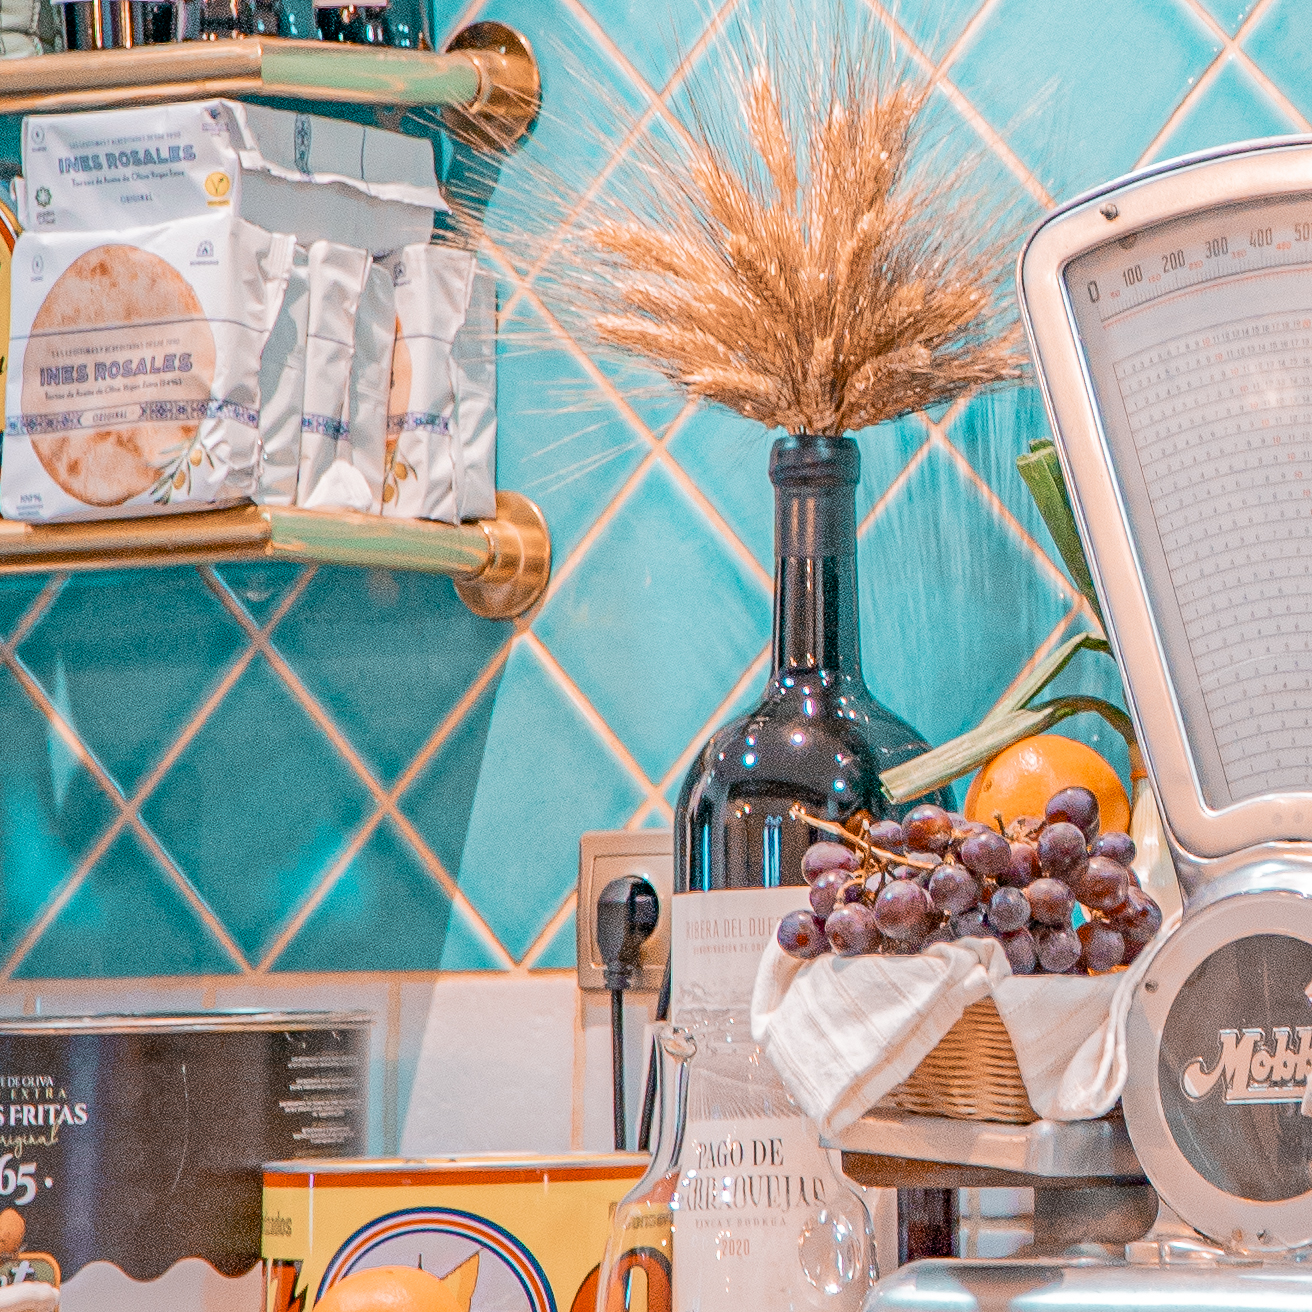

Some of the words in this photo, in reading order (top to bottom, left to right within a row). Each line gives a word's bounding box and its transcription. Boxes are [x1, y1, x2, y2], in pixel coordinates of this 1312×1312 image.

[58, 154, 104, 176] INES
[105, 144, 197, 170] ROSALES
[1087, 280, 1100, 303] 0
[1122, 264, 1143, 288] 100
[1162, 249, 1186, 274] 200
[1205, 236, 1229, 260] 300
[1249, 226, 1273, 248] 400
[40, 363, 89, 387] INES
[94, 352, 193, 382] ROSALES
[685, 919, 720, 940] RIBERA
[723, 918, 745, 938] DEL
[749, 916, 783, 937] DUE
[10, 1087, 68, 1101] EXTRA
[21, 1075, 55, 1088] OLIVA
[9, 1101, 90, 1127] FRITAS
[698, 1140, 744, 1170] PAGO
[752, 1138, 784, 1167] DE
[721, 1238, 751, 1257] 2020
